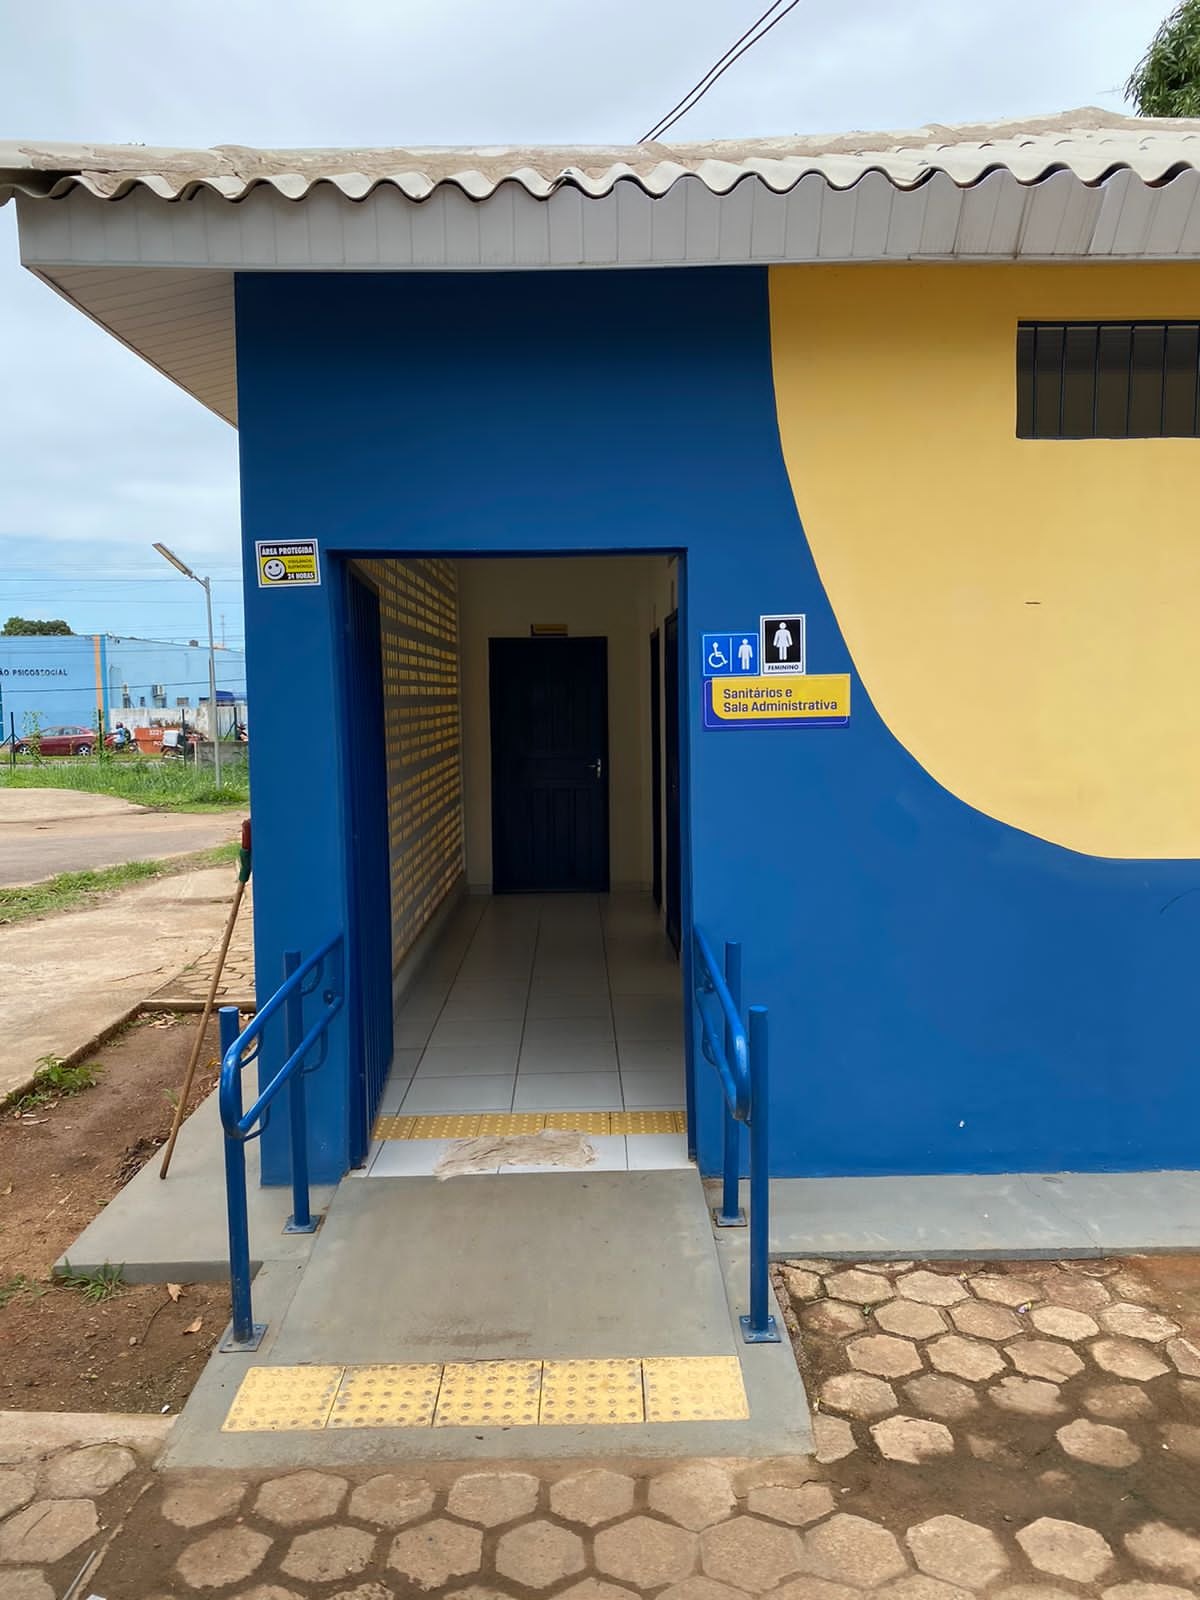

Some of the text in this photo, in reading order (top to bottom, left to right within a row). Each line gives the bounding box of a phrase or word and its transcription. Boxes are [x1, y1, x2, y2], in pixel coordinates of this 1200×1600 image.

[279, 546, 313, 555] PROTEGIDA
[723, 688, 793, 699] Sanitários e
[723, 699, 838, 712] Sala Administrativa
